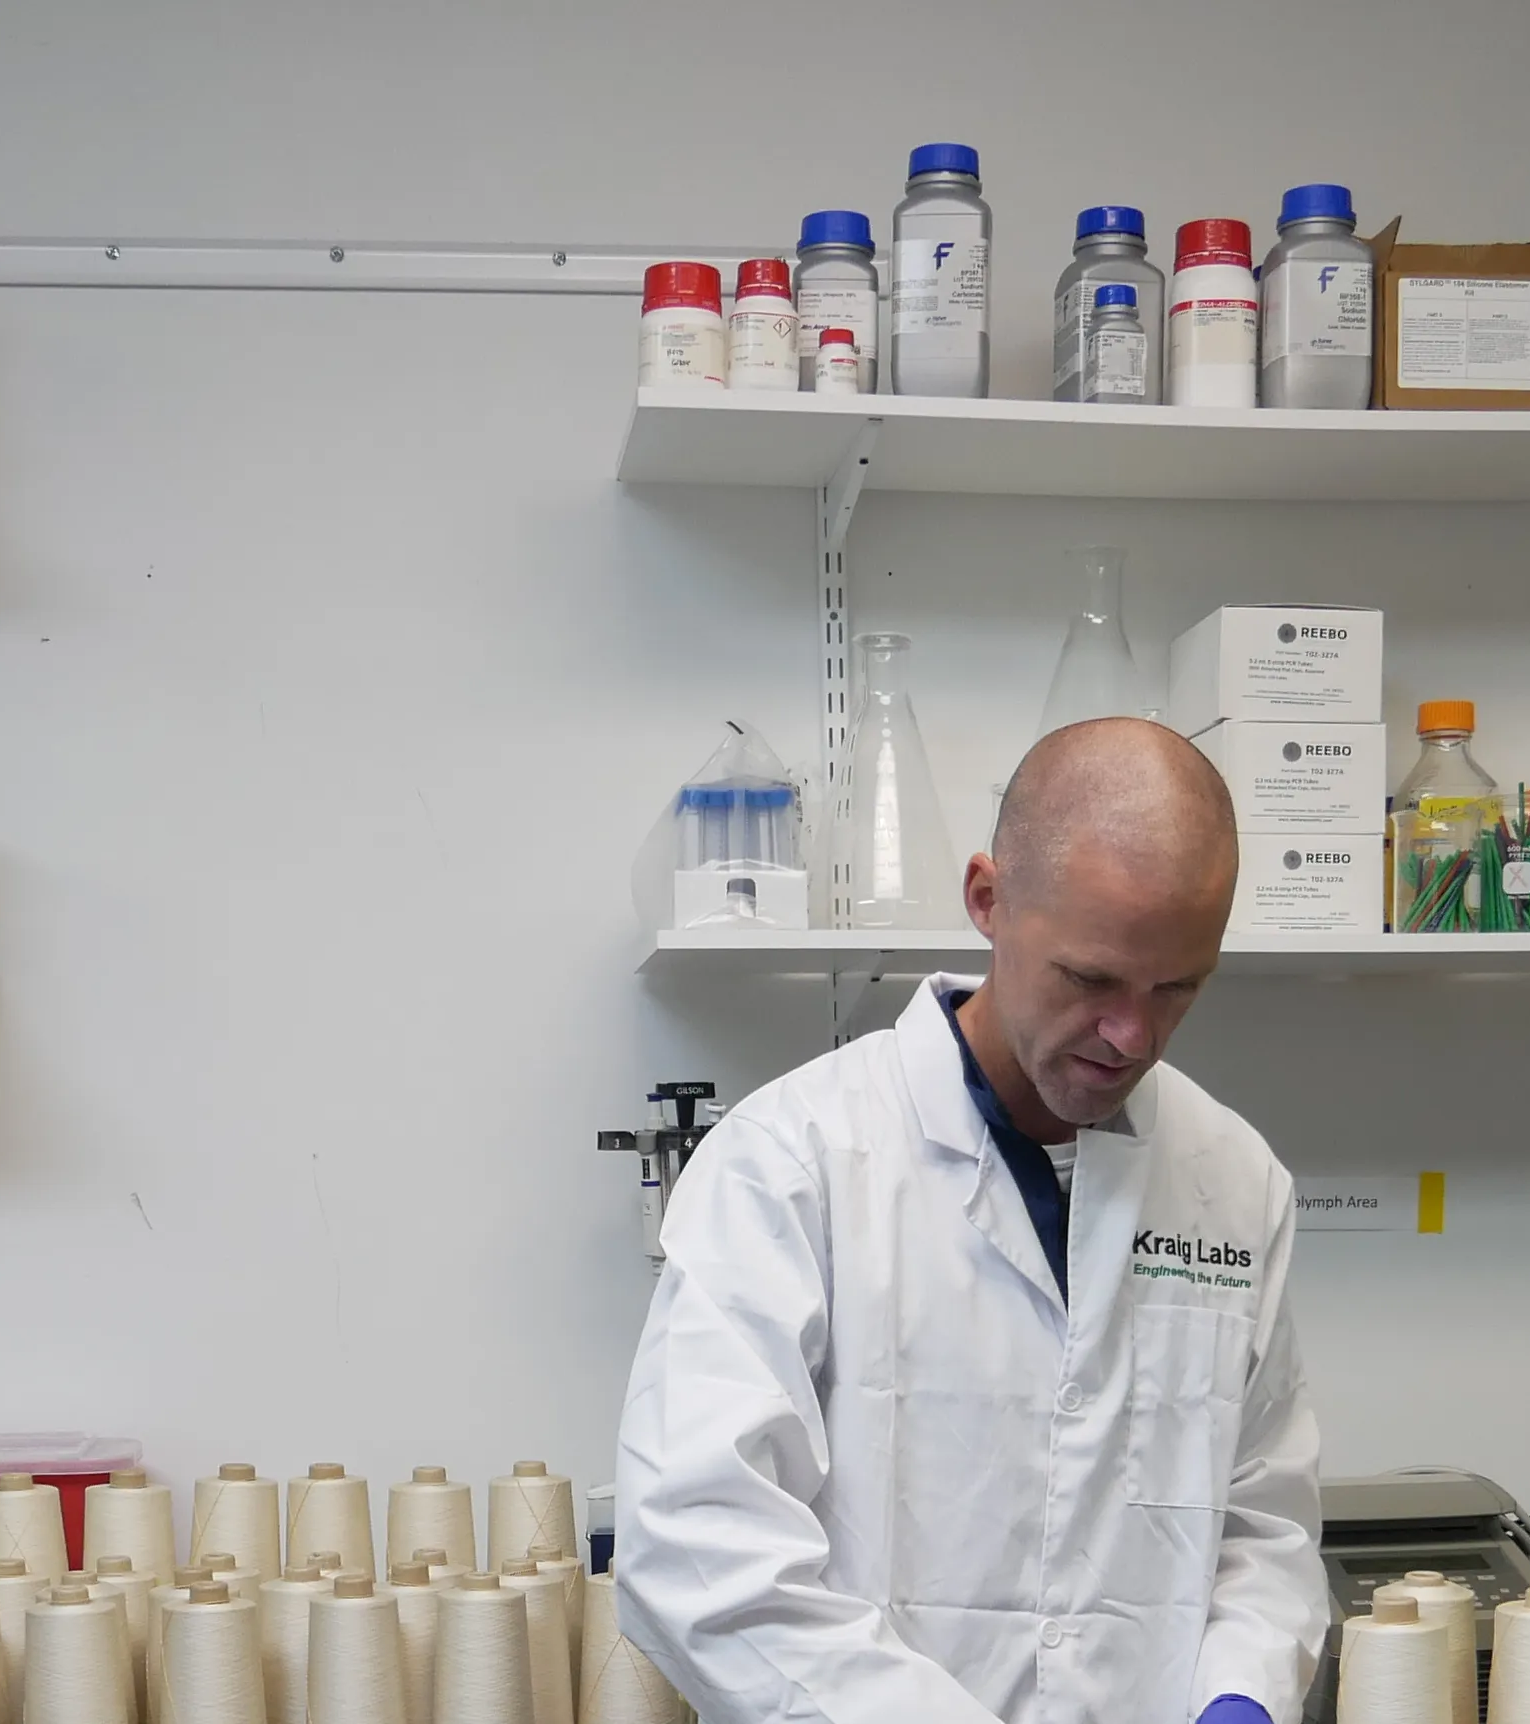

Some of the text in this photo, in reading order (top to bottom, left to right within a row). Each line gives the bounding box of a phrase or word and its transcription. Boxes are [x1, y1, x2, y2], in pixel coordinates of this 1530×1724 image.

[1301, 627, 1348, 640] REEBO
[1305, 745, 1352, 756] REEBO
[1305, 853, 1351, 864] REEBO
[1295, 1194, 1379, 1212] olymph Area
[1132, 1229, 1252, 1268] Kraig Labs
[1133, 1263, 1252, 1288] Engineering the Future
